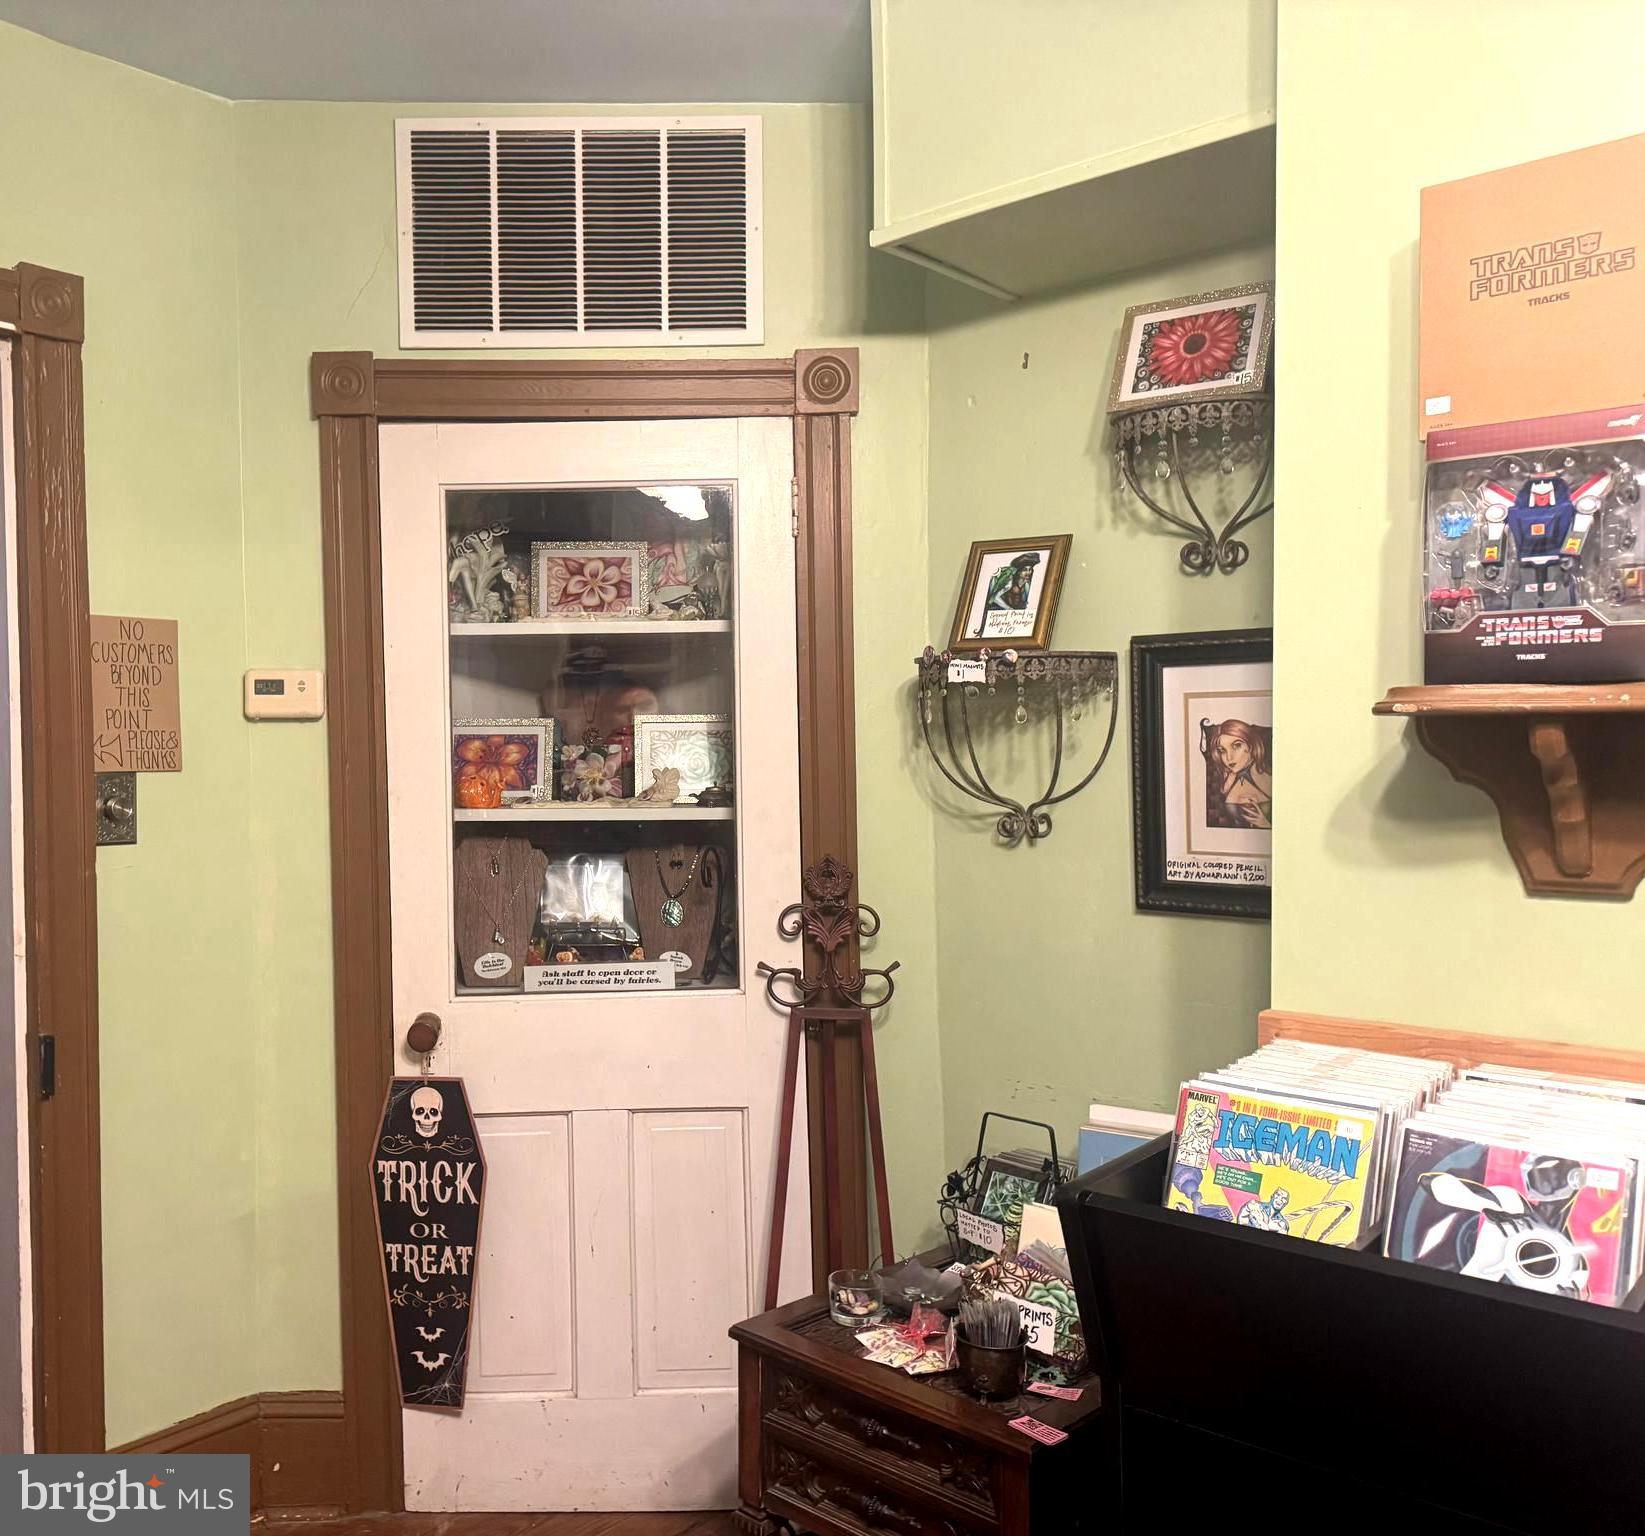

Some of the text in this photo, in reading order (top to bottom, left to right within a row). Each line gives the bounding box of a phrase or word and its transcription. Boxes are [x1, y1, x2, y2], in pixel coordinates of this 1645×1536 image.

[1470, 236, 1575, 278] TRANS
[1469, 246, 1636, 301] FORMERS
[1527, 291, 1570, 307] TRACKS
[119, 620, 144, 641] NO
[1481, 615, 1550, 632] TRANS
[1495, 627, 1604, 646] FORMERS
[91, 642, 174, 664] CUSTOMERS
[110, 664, 162, 686] BEYOND
[115, 687, 150, 707] THIS
[105, 708, 153, 730] POINT
[126, 750, 177, 770] THANKS
[1167, 860, 1263, 872] ORIGINAL COLORED PENCIL
[1167, 870, 1181, 878] ART
[1184, 870, 1194, 879] BY
[537, 975, 662, 987] you'll be cursed by fairies.
[542, 970, 560, 978] Ask
[587, 969, 597, 977] to
[599, 969, 621, 978] open
[623, 968, 645, 976] door
[1188, 1091, 1217, 1105] MARVEL
[1242, 1102, 1251, 1113] IN
[1251, 1103, 1257, 1114] A
[1258, 1105, 1301, 1122] FOUR-ISSUE
[1302, 1112, 1332, 1130] LIMITED
[1213, 1108, 1361, 1180] ICEMAN
[377, 1160, 479, 1217] TRICK
[960, 1213, 976, 1223] LOCAL
[409, 1222, 448, 1239] OR
[385, 1243, 473, 1283] TREAT
[1019, 1304, 1053, 1327] PRINTS
